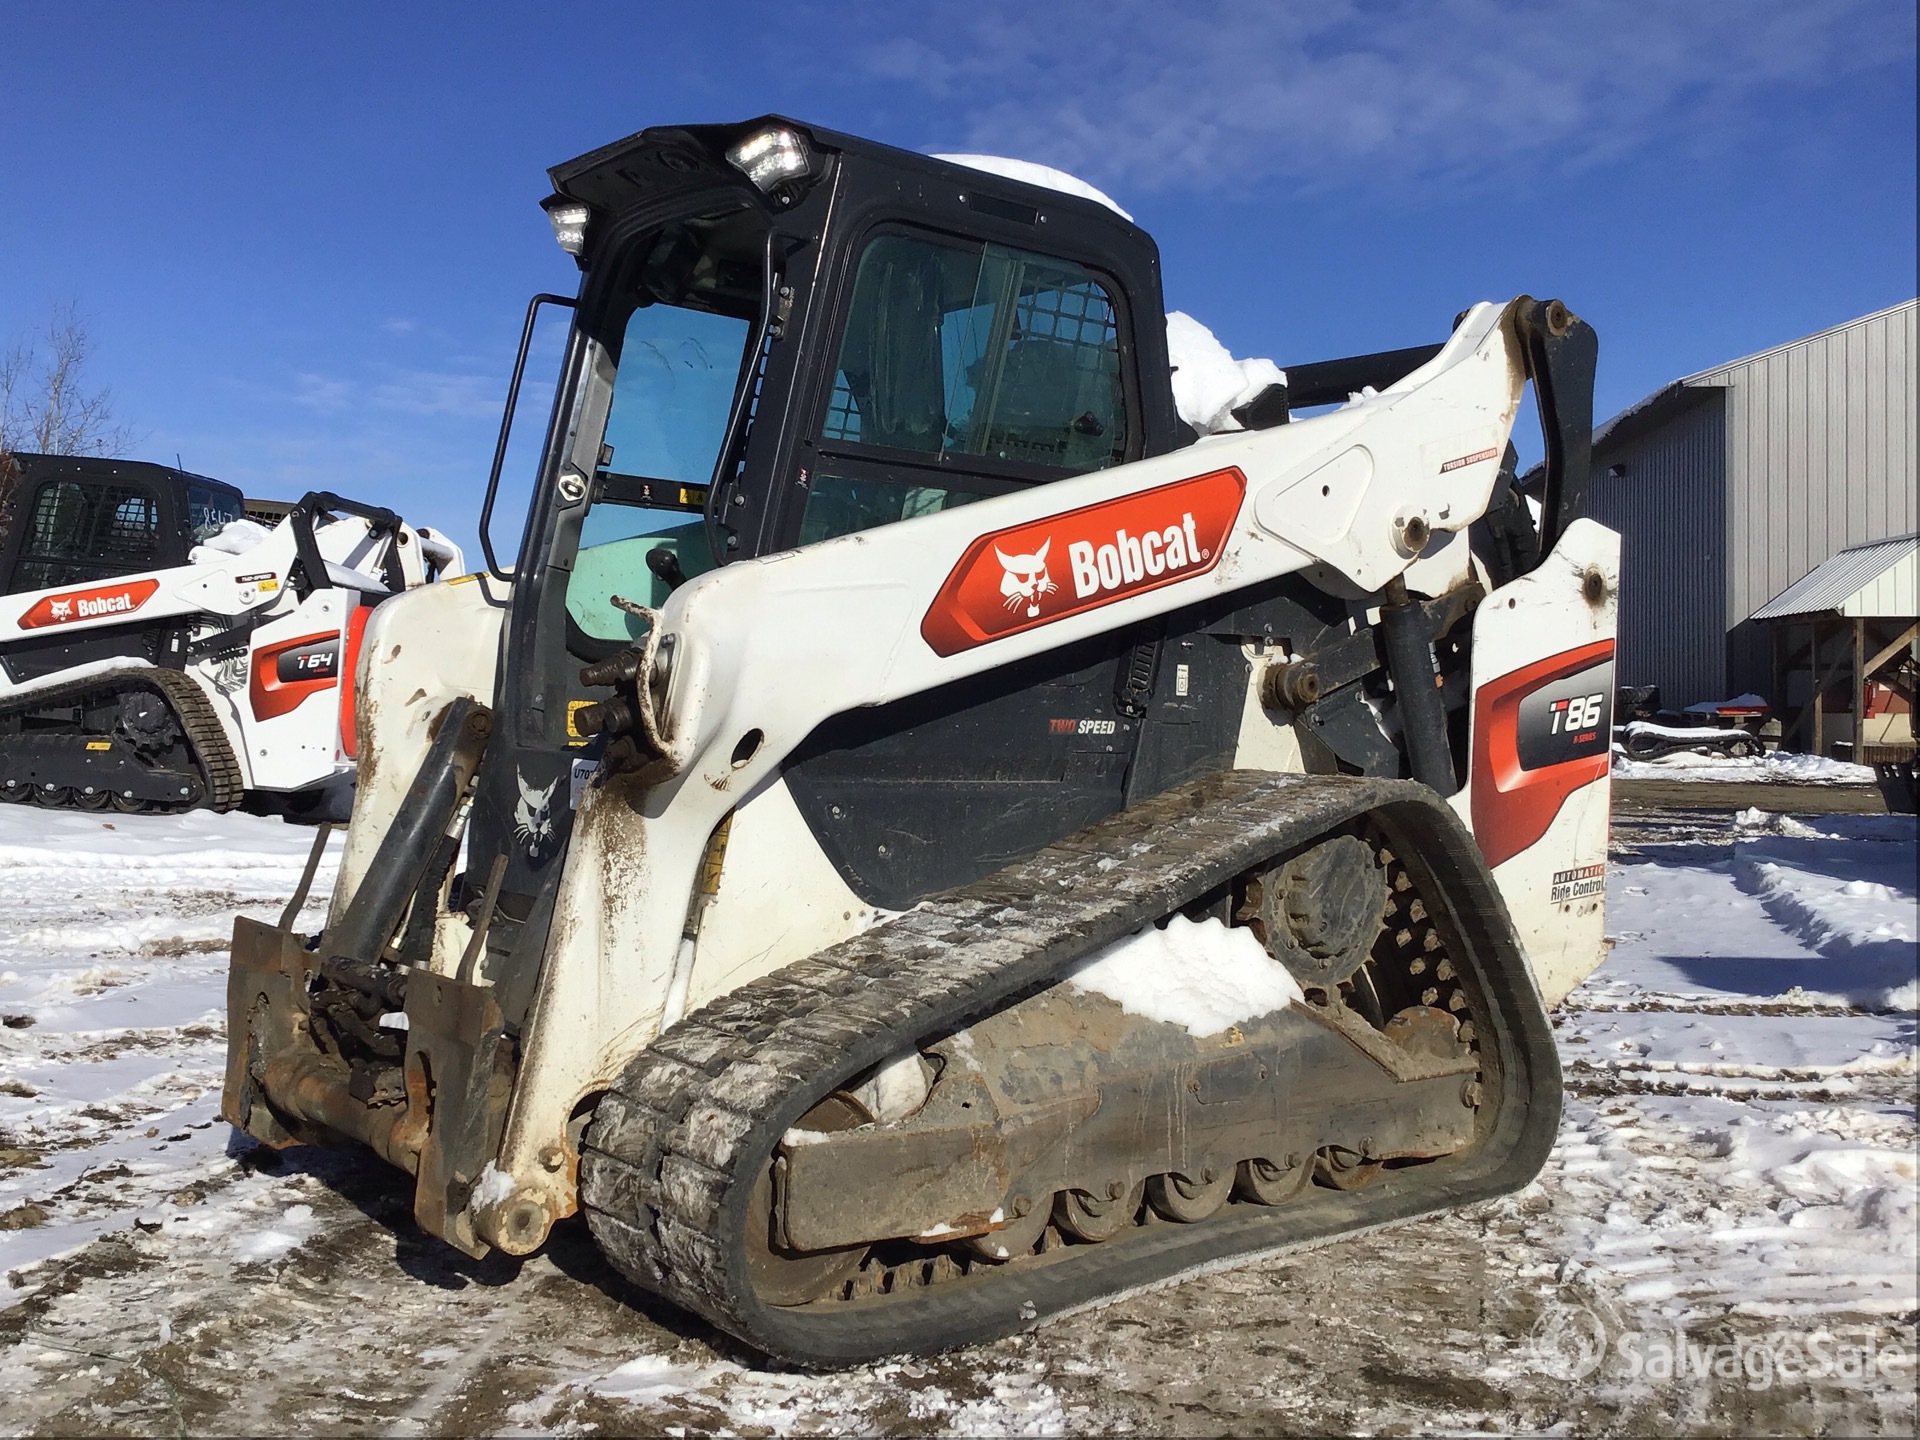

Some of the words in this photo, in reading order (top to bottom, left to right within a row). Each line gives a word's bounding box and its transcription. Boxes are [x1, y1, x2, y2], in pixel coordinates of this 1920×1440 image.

[1443, 457, 1466, 472] TORSION
[1466, 448, 1497, 464] SUSPENSION
[1068, 512, 1202, 600] Bobcat
[77, 592, 132, 617] Bobcat
[297, 652, 333, 670] T64
[1549, 692, 1604, 735] T86
[1049, 718, 1077, 734] TWO
[1077, 719, 1116, 735] SPEED
[1554, 864, 1605, 885] AUTOMATIC
[1551, 884, 1571, 902] Ride
[1572, 875, 1607, 897] Control
